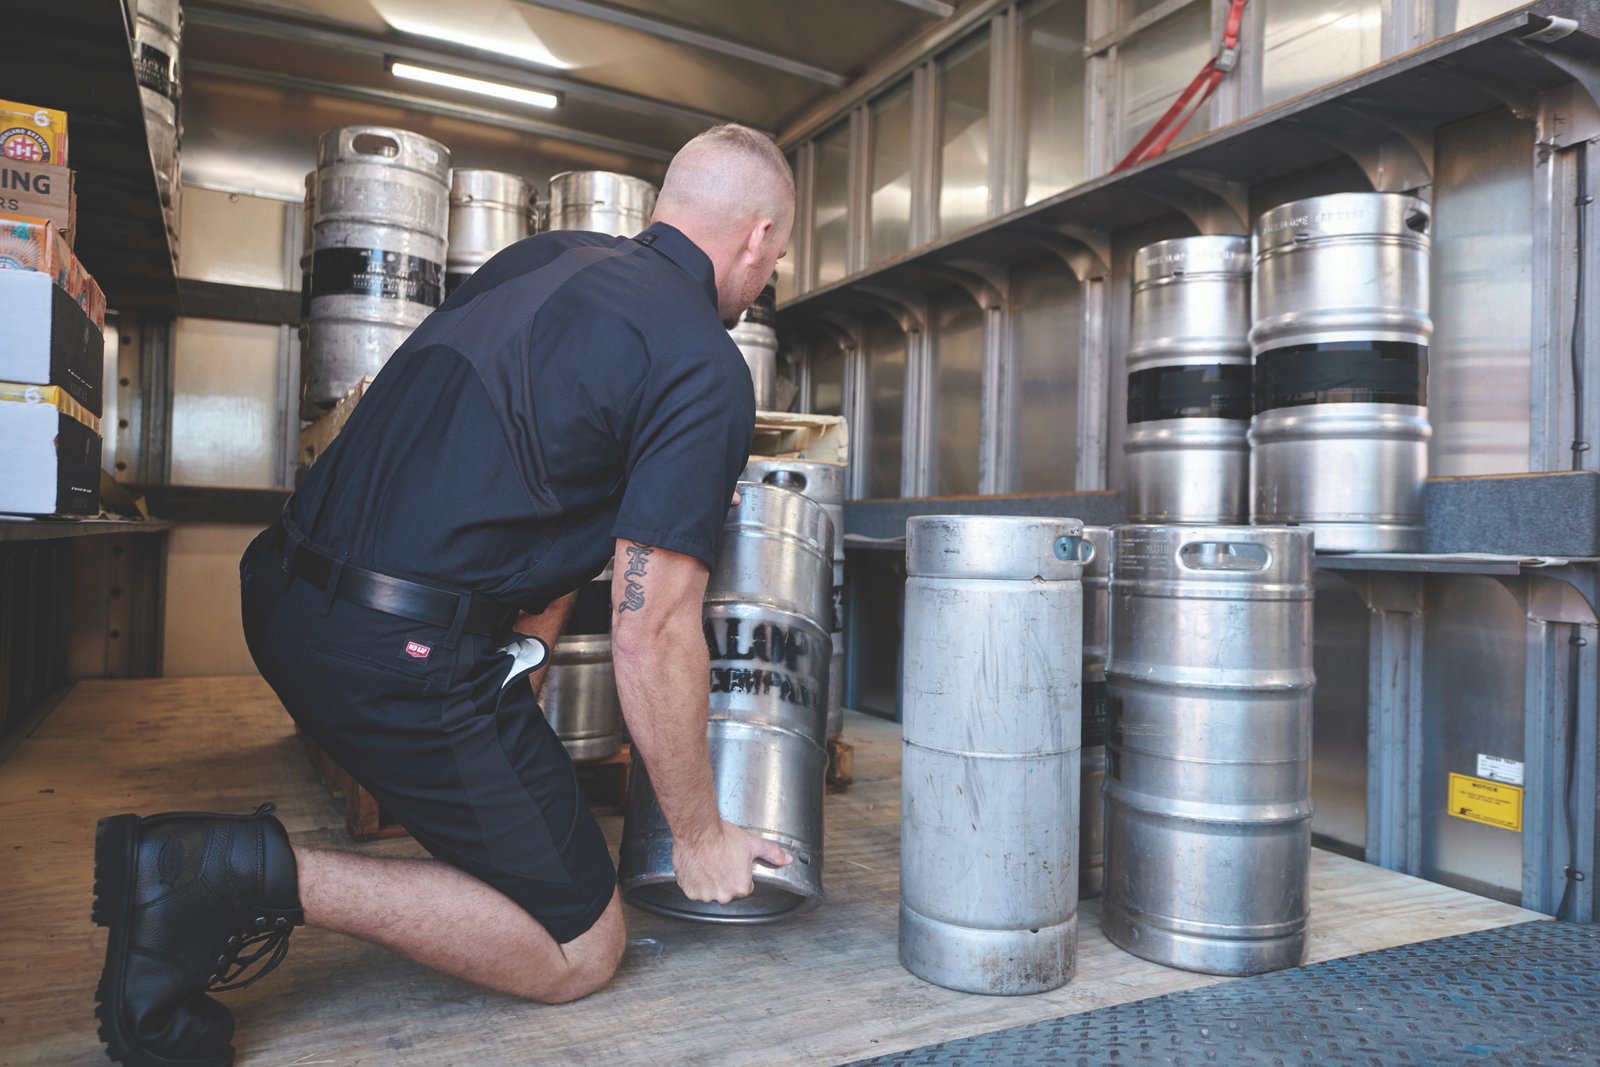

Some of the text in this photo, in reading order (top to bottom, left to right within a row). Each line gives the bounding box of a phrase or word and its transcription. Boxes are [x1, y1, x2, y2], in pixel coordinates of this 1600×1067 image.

[34, 110, 50, 126] 6
[2, 169, 50, 195] ING
[14, 222, 30, 240] 4
